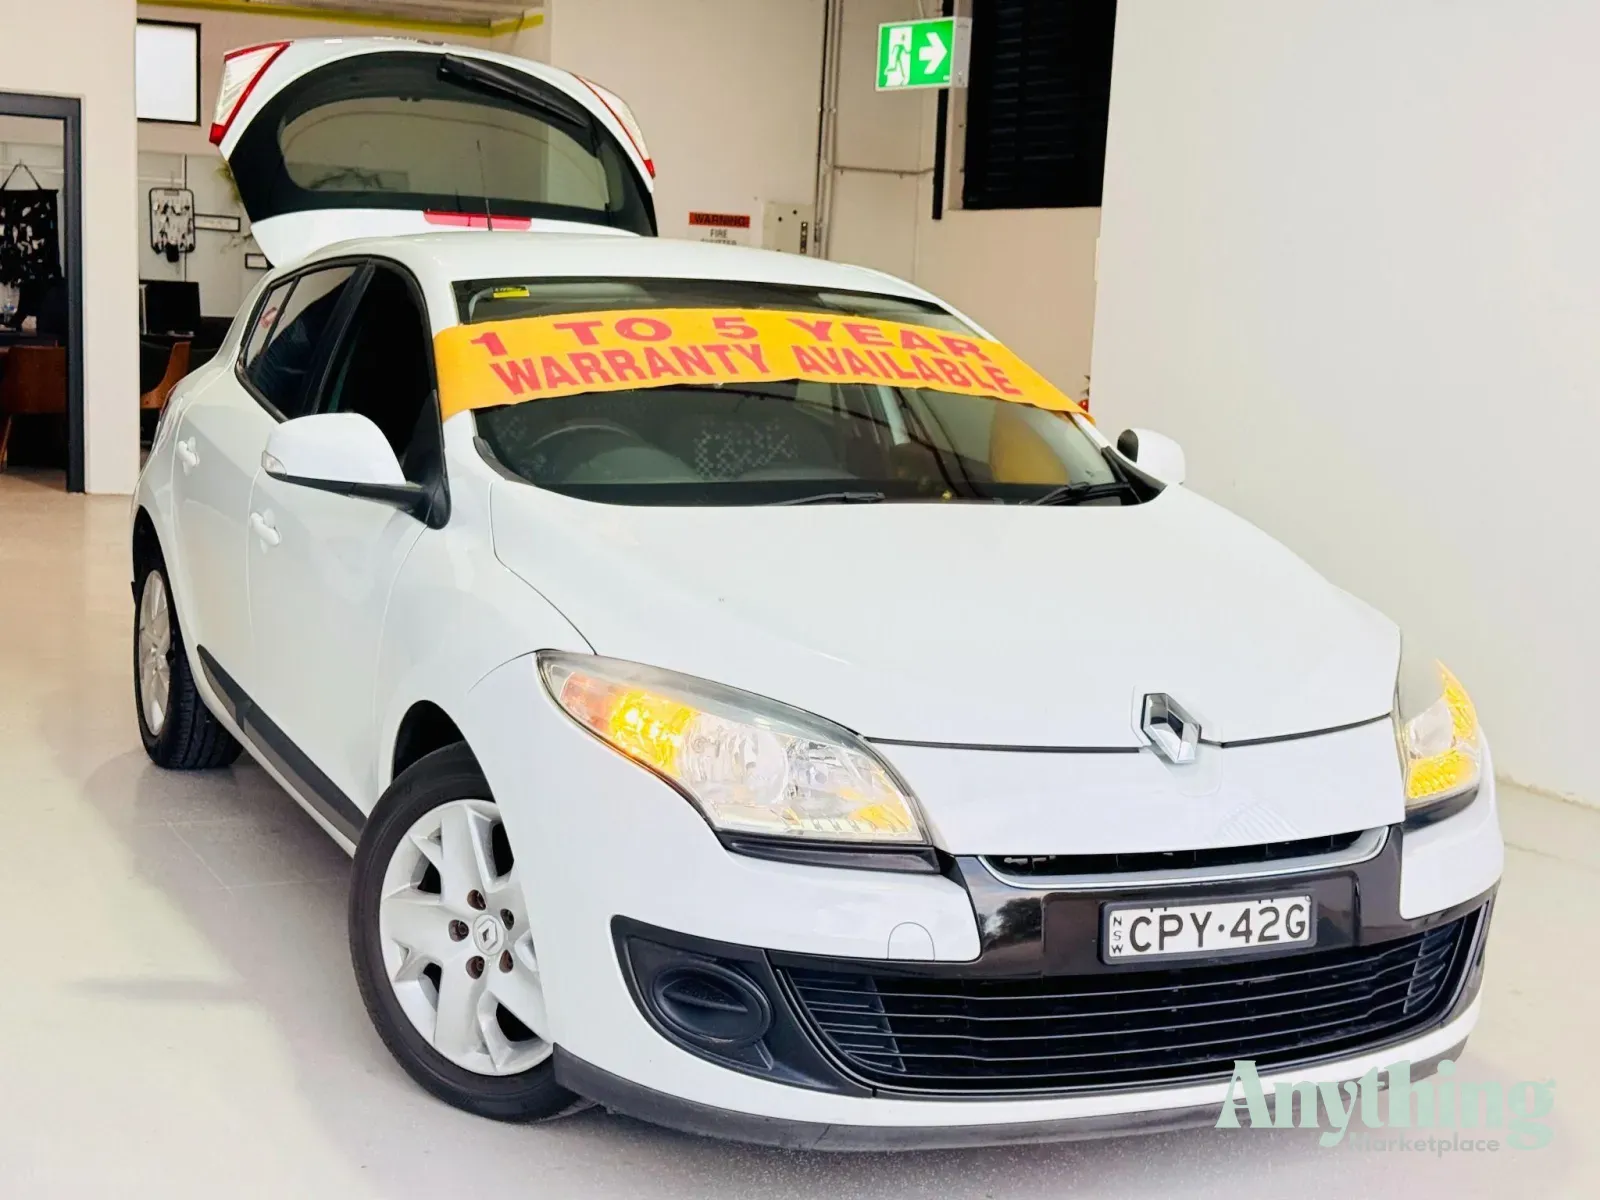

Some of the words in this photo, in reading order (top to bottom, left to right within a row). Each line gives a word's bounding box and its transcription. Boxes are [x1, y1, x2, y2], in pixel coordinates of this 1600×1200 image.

[694, 212, 746, 227] WARNING
[710, 228, 728, 238] FIRE
[471, 331, 508, 356] 1
[553, 317, 672, 346] TO
[712, 316, 758, 340] 5
[788, 317, 992, 362] YEAR
[489, 343, 771, 395] WARRANTY
[791, 345, 1023, 396] AVAILABLE
